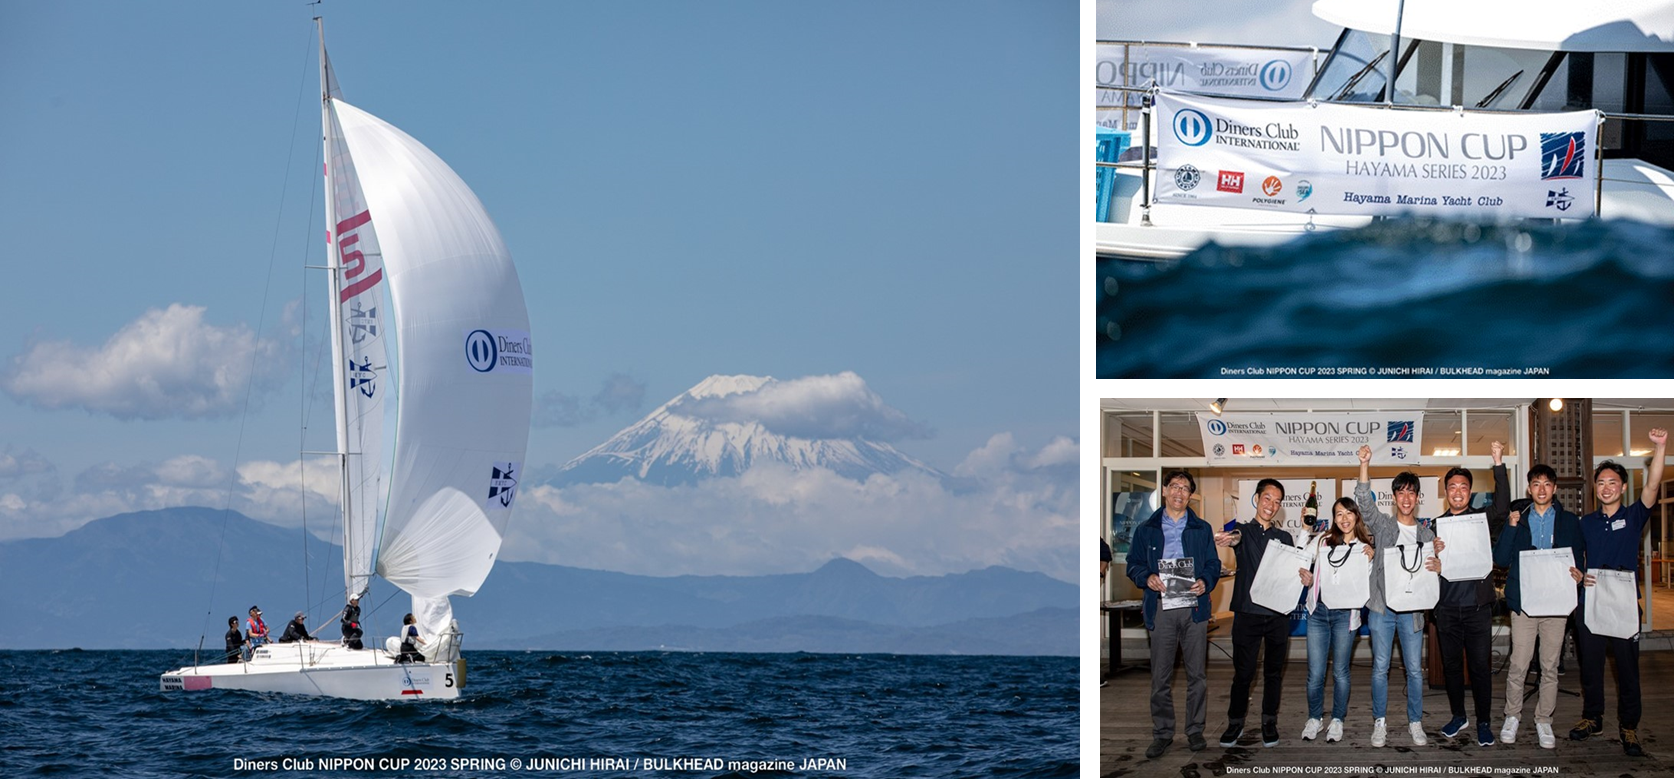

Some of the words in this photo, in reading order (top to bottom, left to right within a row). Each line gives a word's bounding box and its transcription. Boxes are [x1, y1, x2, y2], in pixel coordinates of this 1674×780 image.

[1216, 118, 1262, 138] Diners
[1265, 122, 1299, 140] Club
[1216, 135, 1300, 152] INTERNATIONAL
[1321, 125, 1449, 159] NIPPON
[1461, 133, 1528, 160] CUP
[1346, 160, 1417, 178] HAYAMA
[1422, 163, 1467, 180] SERIES
[1471, 164, 1507, 181] 2023
[1221, 174, 1240, 187] HH
[1252, 197, 1286, 206] POLYGIENE
[1343, 191, 1391, 205] Hayama
[1396, 194, 1438, 206] Marina
[1442, 195, 1472, 206] Yacht
[1477, 196, 1504, 206] Club
[498, 335, 523, 354] Diners
[1226, 421, 1249, 429] Diners
[1249, 421, 1266, 430] Club
[1275, 421, 1340, 435] NIPPON
[1345, 421, 1381, 435] CUP
[1288, 436, 1323, 444] HAYAMA
[1325, 436, 1350, 444] SERIES
[1351, 435, 1369, 443] 2023
[1377, 491, 1393, 500] Din
[1286, 519, 1302, 529] CU
[1178, 560, 1194, 569] Club
[445, 673, 454, 688] 5
